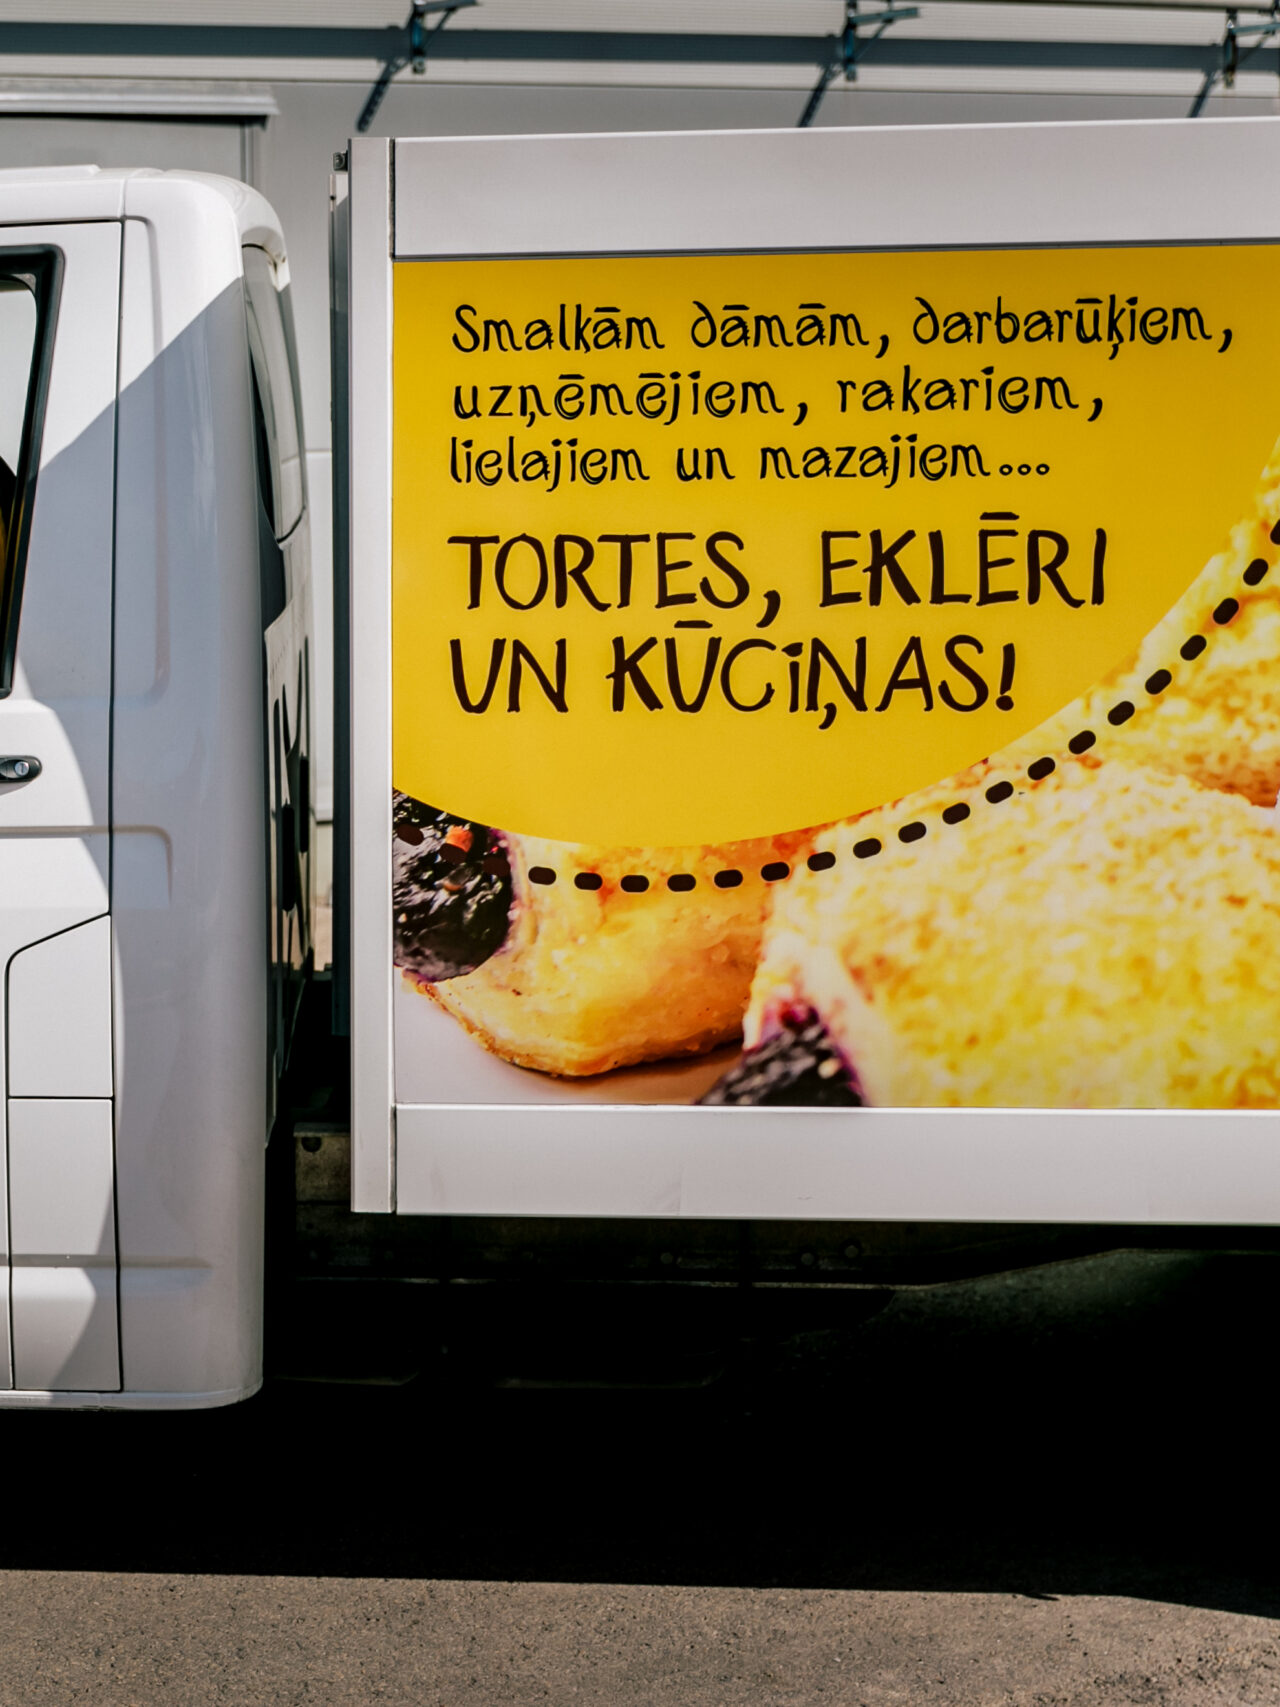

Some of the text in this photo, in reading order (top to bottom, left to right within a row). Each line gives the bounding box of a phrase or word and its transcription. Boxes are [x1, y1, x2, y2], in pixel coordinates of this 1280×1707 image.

[452, 293, 1233, 361] Smalkām dāmām, darbarūķiem,
[454, 370, 808, 428] uzņēmējiem,
[450, 433, 1051, 492] lielajiem un mazajiem...
[447, 511, 1107, 629] TORTES, EKLĒRI
[449, 638, 569, 714] UN
